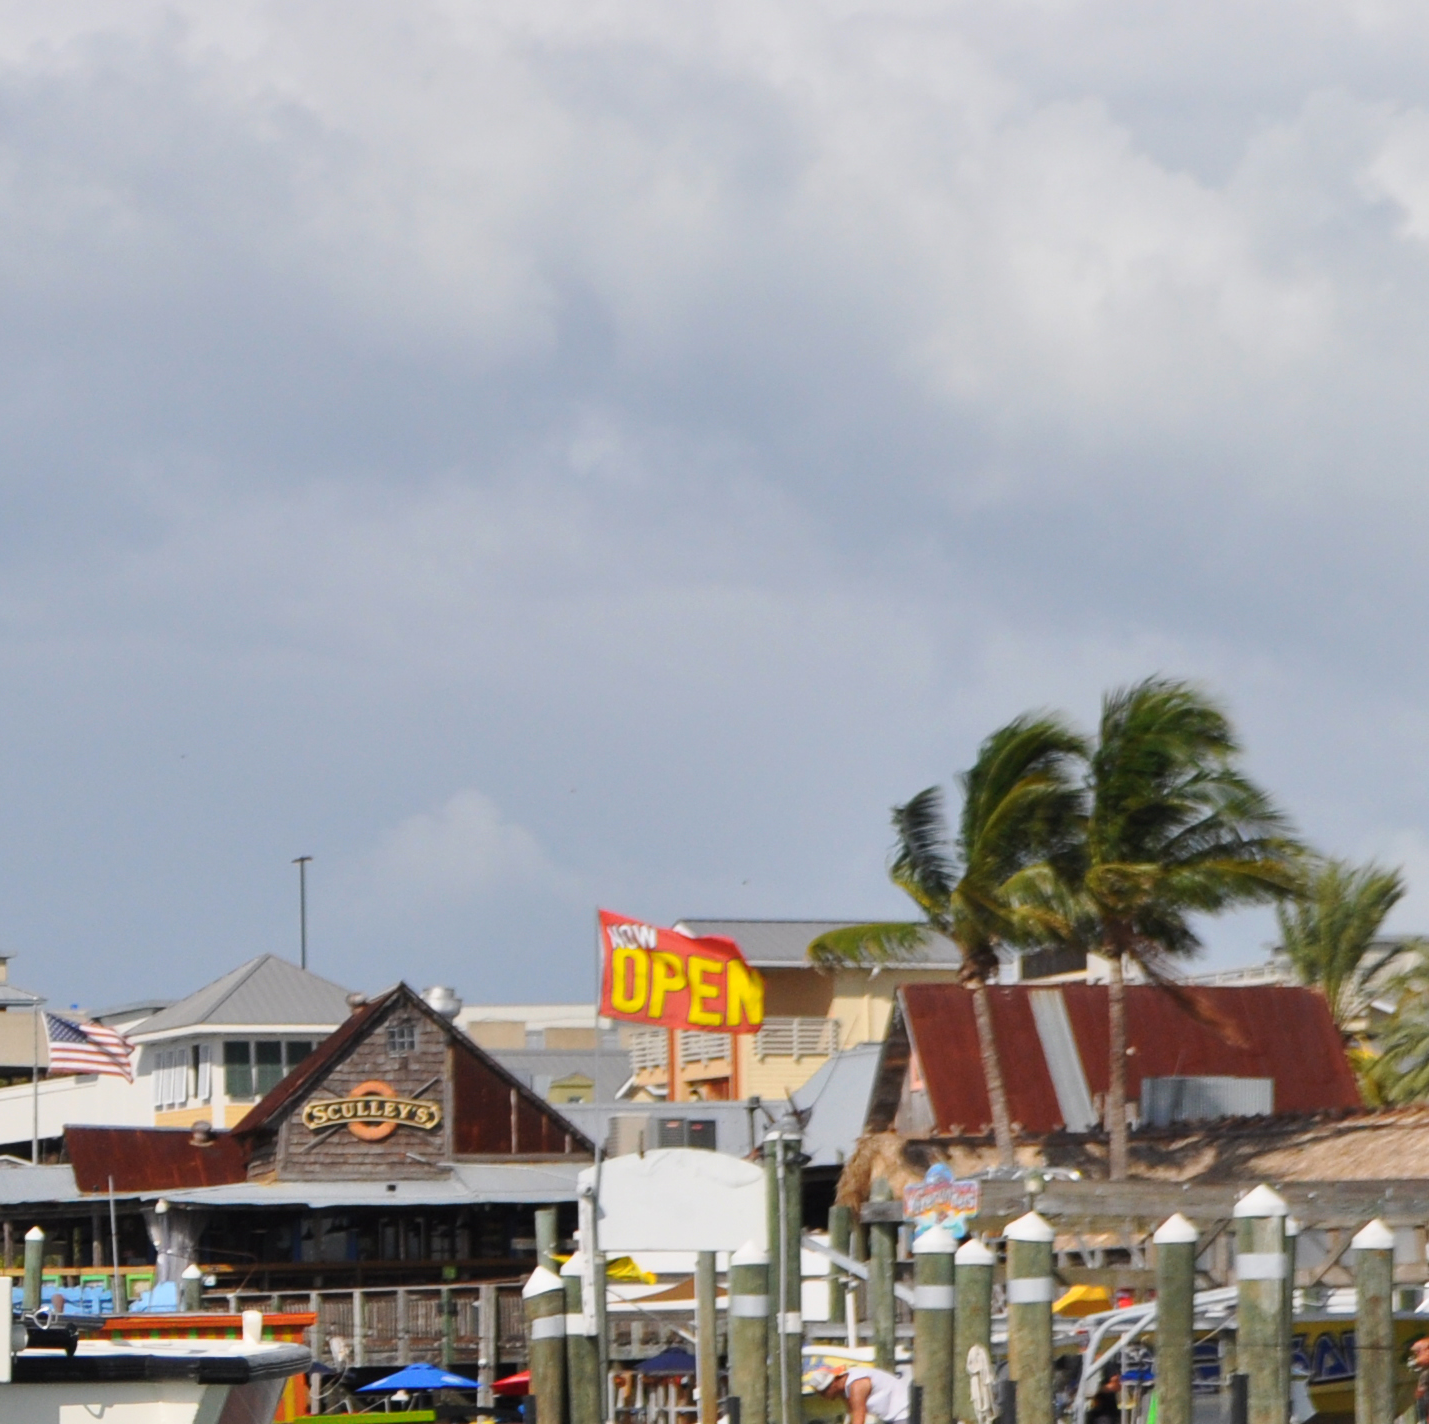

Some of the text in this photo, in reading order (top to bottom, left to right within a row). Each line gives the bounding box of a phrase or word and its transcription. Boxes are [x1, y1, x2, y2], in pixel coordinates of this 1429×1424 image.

[606, 924, 658, 949] NOW
[611, 947, 765, 1027] OPEN
[312, 1100, 430, 1123] SCULLEY'S
